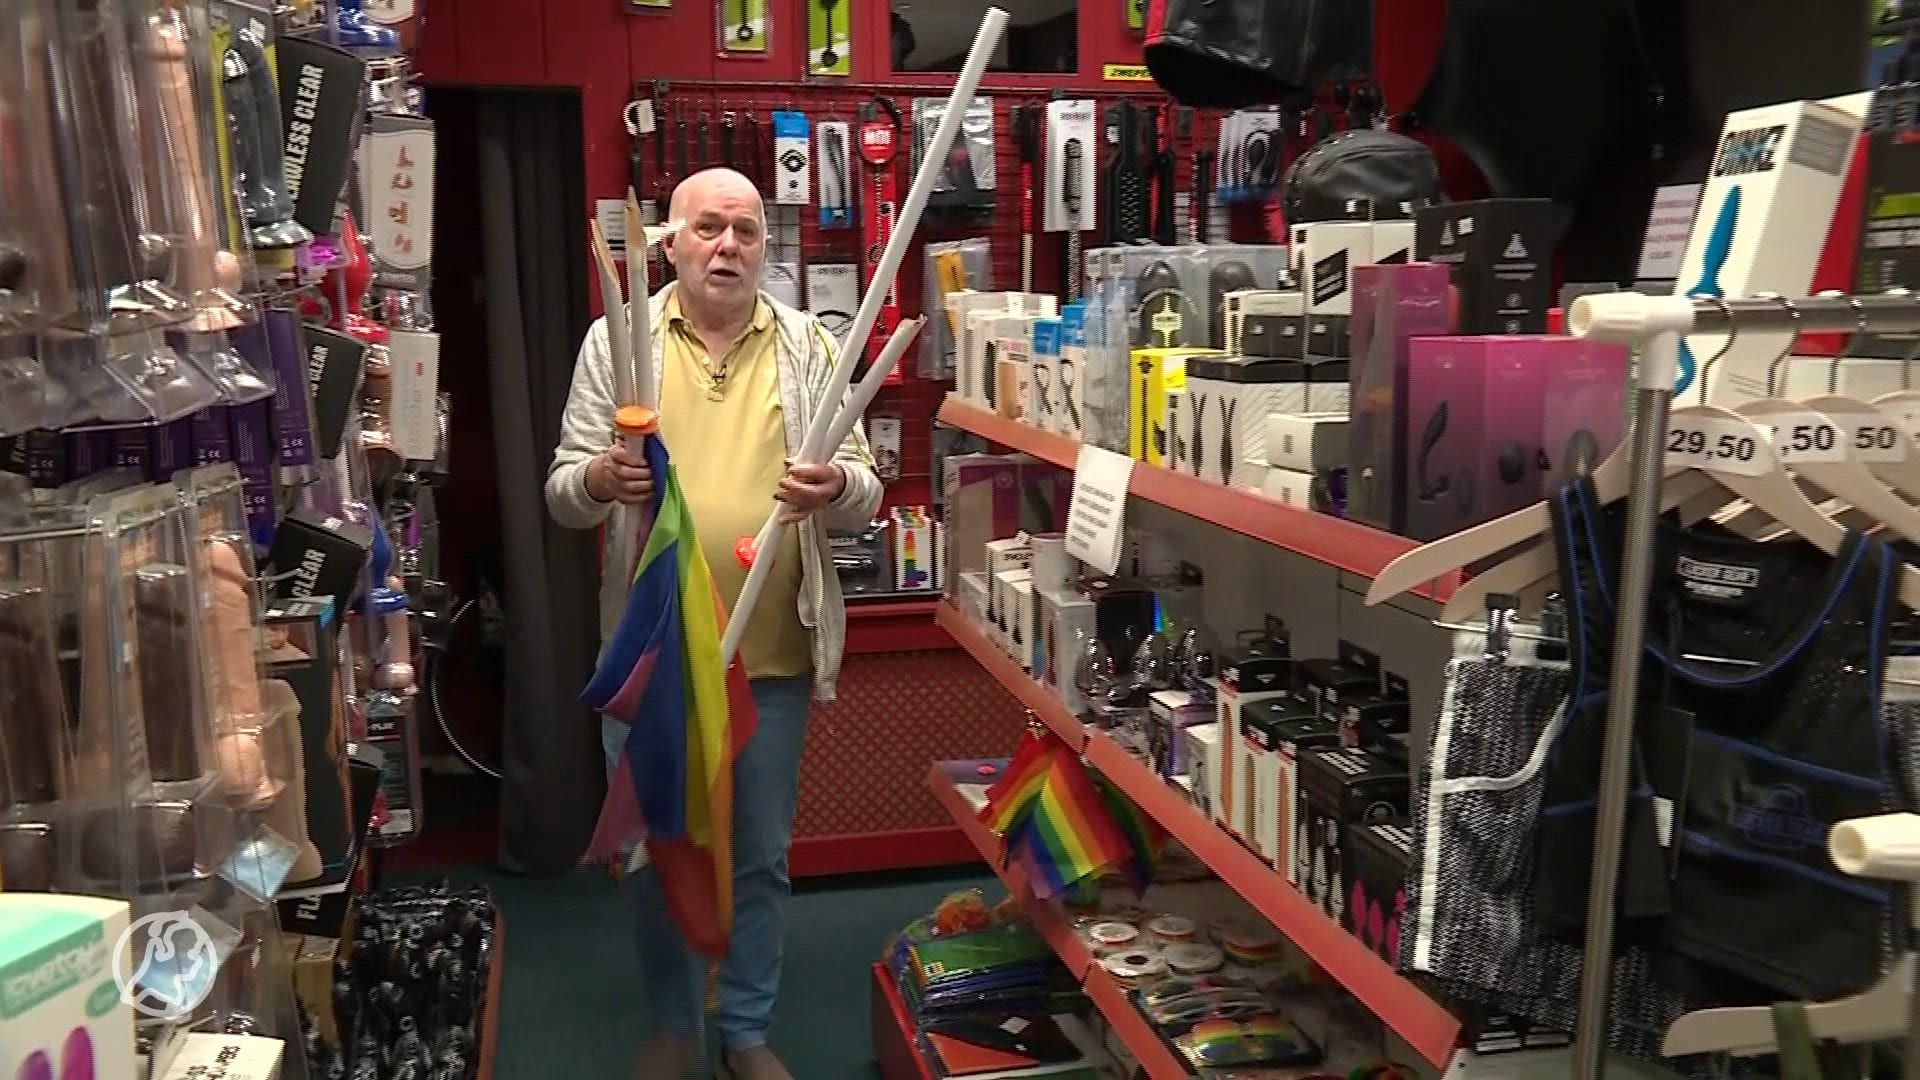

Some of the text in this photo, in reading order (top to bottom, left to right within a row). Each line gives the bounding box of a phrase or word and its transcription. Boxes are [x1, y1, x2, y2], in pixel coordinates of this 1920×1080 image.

[294, 64, 324, 119] CLEAR
[1668, 428, 1756, 461] 29,50
[1771, 425, 1835, 456] ,50
[291, 549, 327, 599] CLEAR
